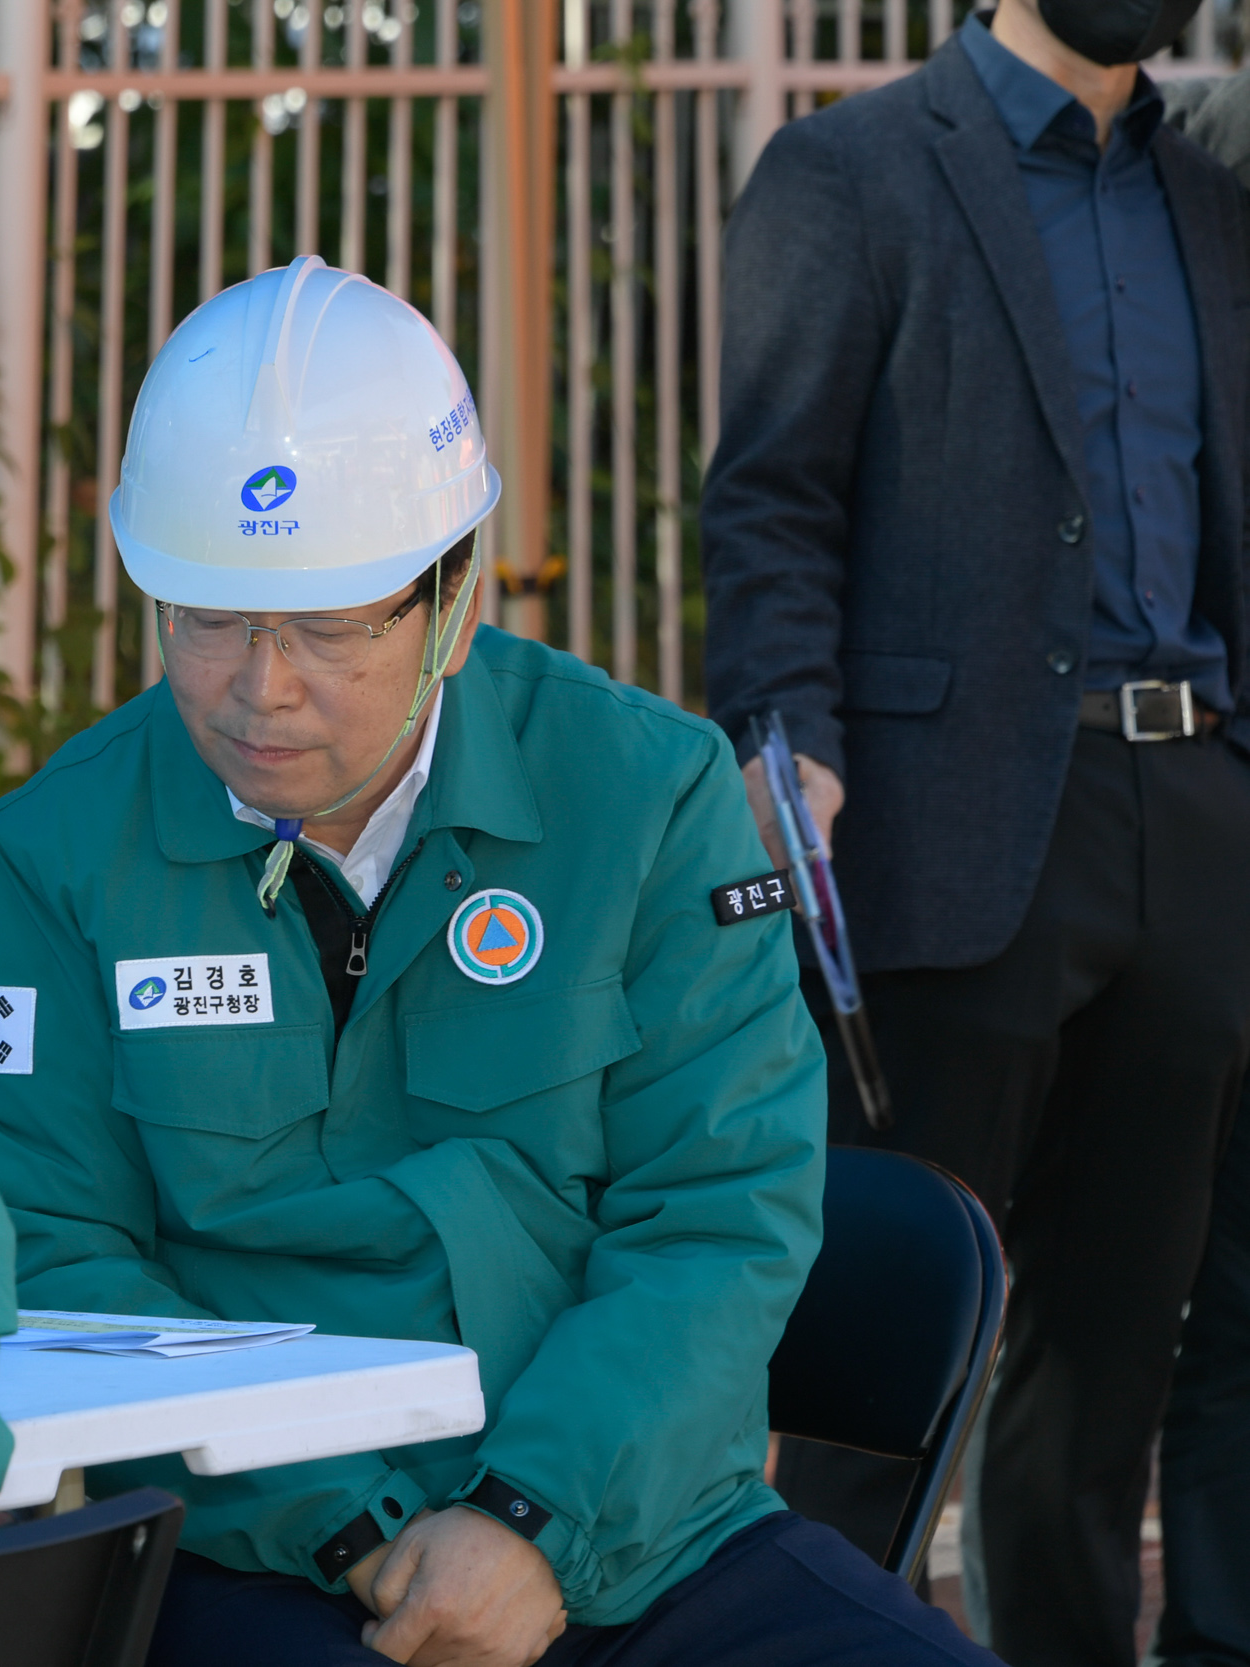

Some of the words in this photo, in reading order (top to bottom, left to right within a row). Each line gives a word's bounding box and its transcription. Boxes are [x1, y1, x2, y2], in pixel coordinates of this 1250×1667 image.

[237, 519, 300, 536] 광진구
[726, 878, 785, 915] 광진구
[173, 994, 260, 1016] 광진구청장
